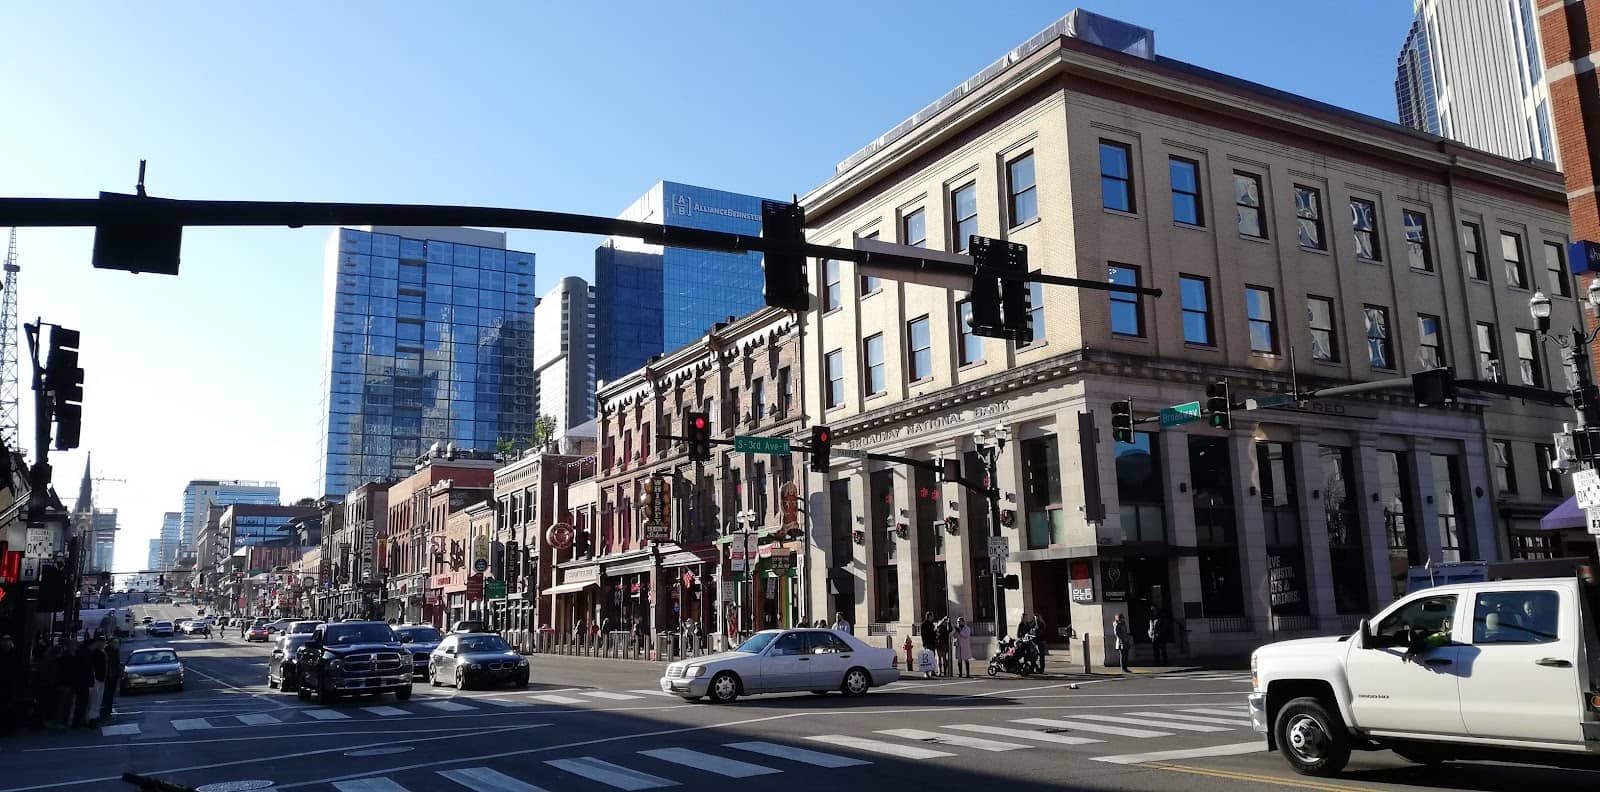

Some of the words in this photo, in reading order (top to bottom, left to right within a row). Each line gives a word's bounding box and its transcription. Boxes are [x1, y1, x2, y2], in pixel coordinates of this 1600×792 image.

[850, 429, 900, 450] BROADWAY
[906, 413, 966, 435] NATIONAL
[974, 399, 1011, 417] BANK
[1162, 409, 1199, 423] Broadway
[653, 479, 662, 526] WHISKEY
[1577, 490, 1589, 503] OK
